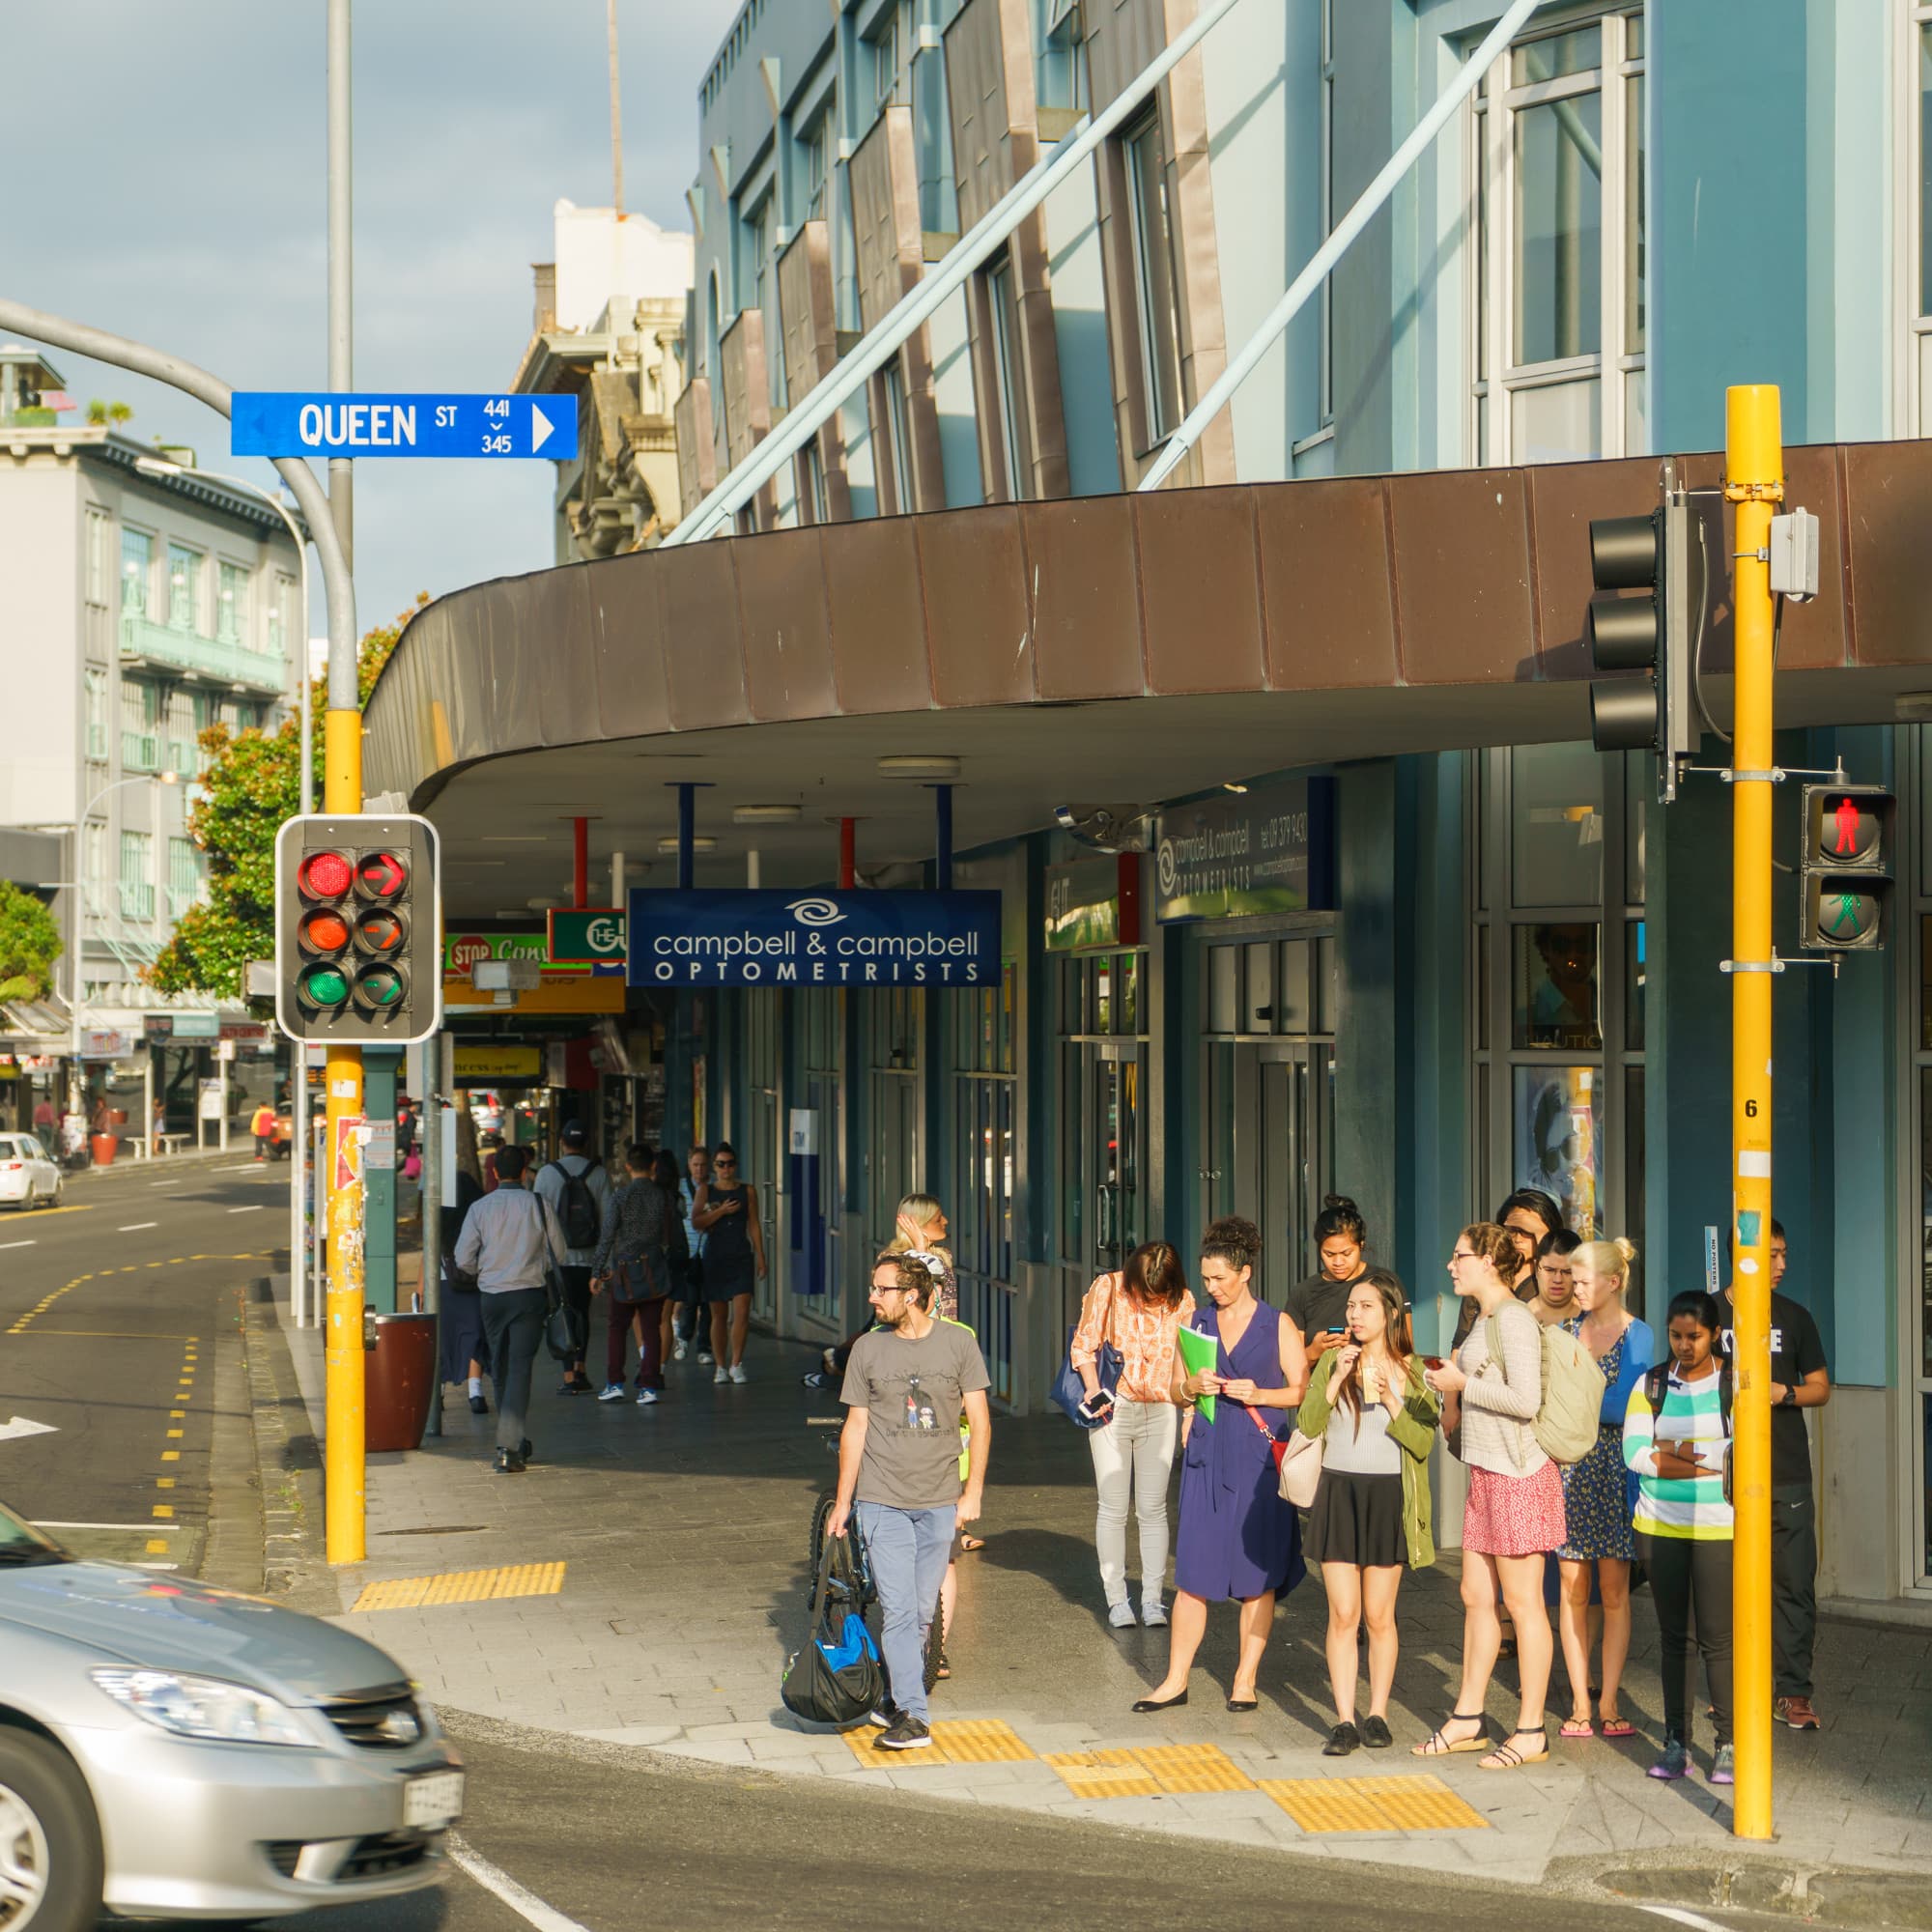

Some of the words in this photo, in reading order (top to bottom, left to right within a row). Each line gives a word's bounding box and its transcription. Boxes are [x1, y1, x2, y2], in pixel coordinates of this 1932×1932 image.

[483, 400, 509, 416] 441
[299, 404, 415, 446] QUEEN
[435, 406, 458, 427] ST
[481, 436, 512, 453] 345
[1176, 866, 1250, 897] OPTOMETRISTS
[593, 928, 615, 943] THE
[455, 945, 490, 964] STOP
[654, 930, 795, 960] campbell
[807, 932, 827, 955] &
[837, 931, 978, 961] campbell
[655, 962, 978, 980] OPTOMETRISTS
[1745, 1099, 1757, 1118] 6
[1711, 1239, 1716, 1250] NO
